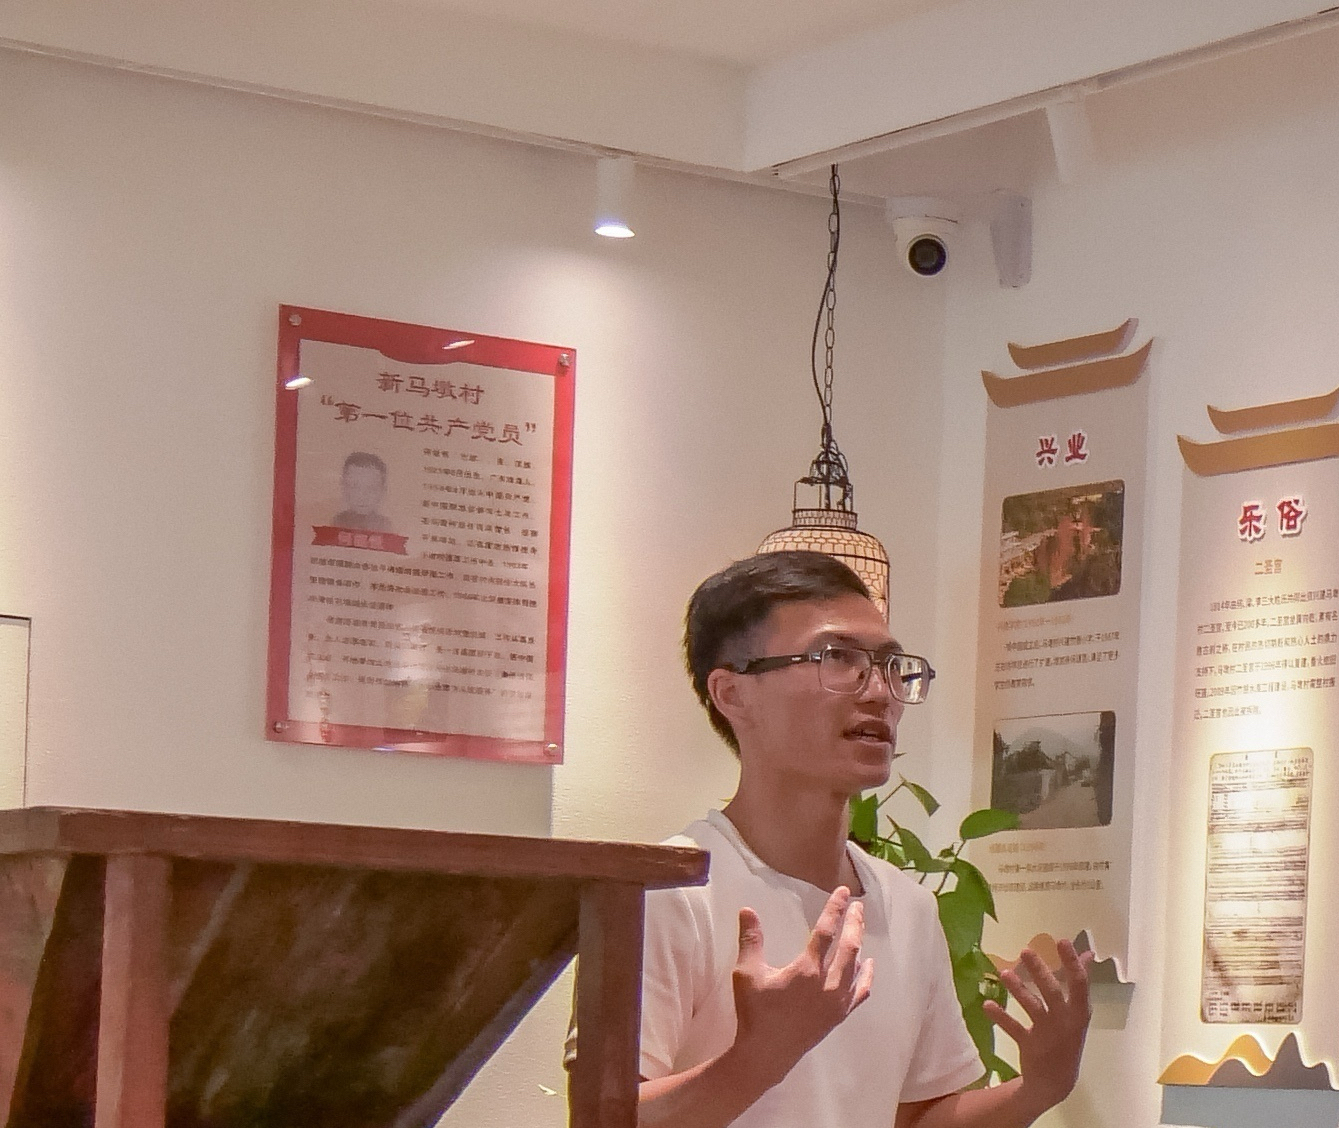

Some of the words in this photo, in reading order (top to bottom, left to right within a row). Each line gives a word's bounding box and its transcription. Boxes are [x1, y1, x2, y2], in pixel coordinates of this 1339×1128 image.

[376, 372, 485, 404] 新马墩村
[1036, 432, 1087, 466] 兴业
[1239, 499, 1303, 537] 乐俗
